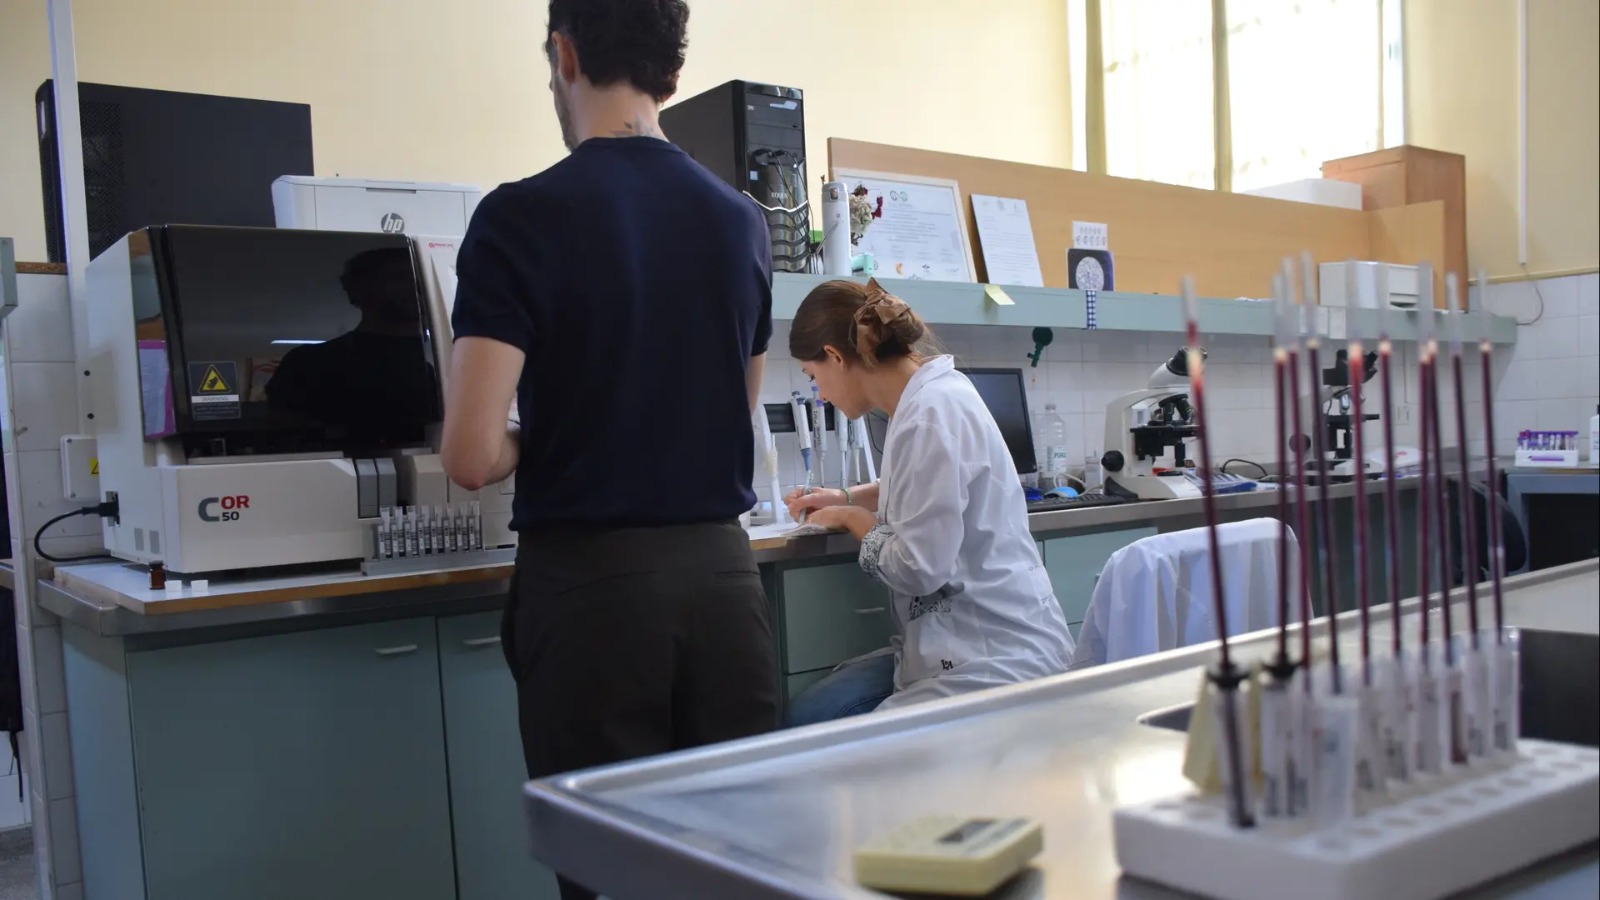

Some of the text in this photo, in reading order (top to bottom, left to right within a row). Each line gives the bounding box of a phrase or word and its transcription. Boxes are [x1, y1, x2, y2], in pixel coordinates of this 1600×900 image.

[383, 212, 403, 233] hp
[198, 495, 250, 522] COR
[222, 511, 240, 521] 50
